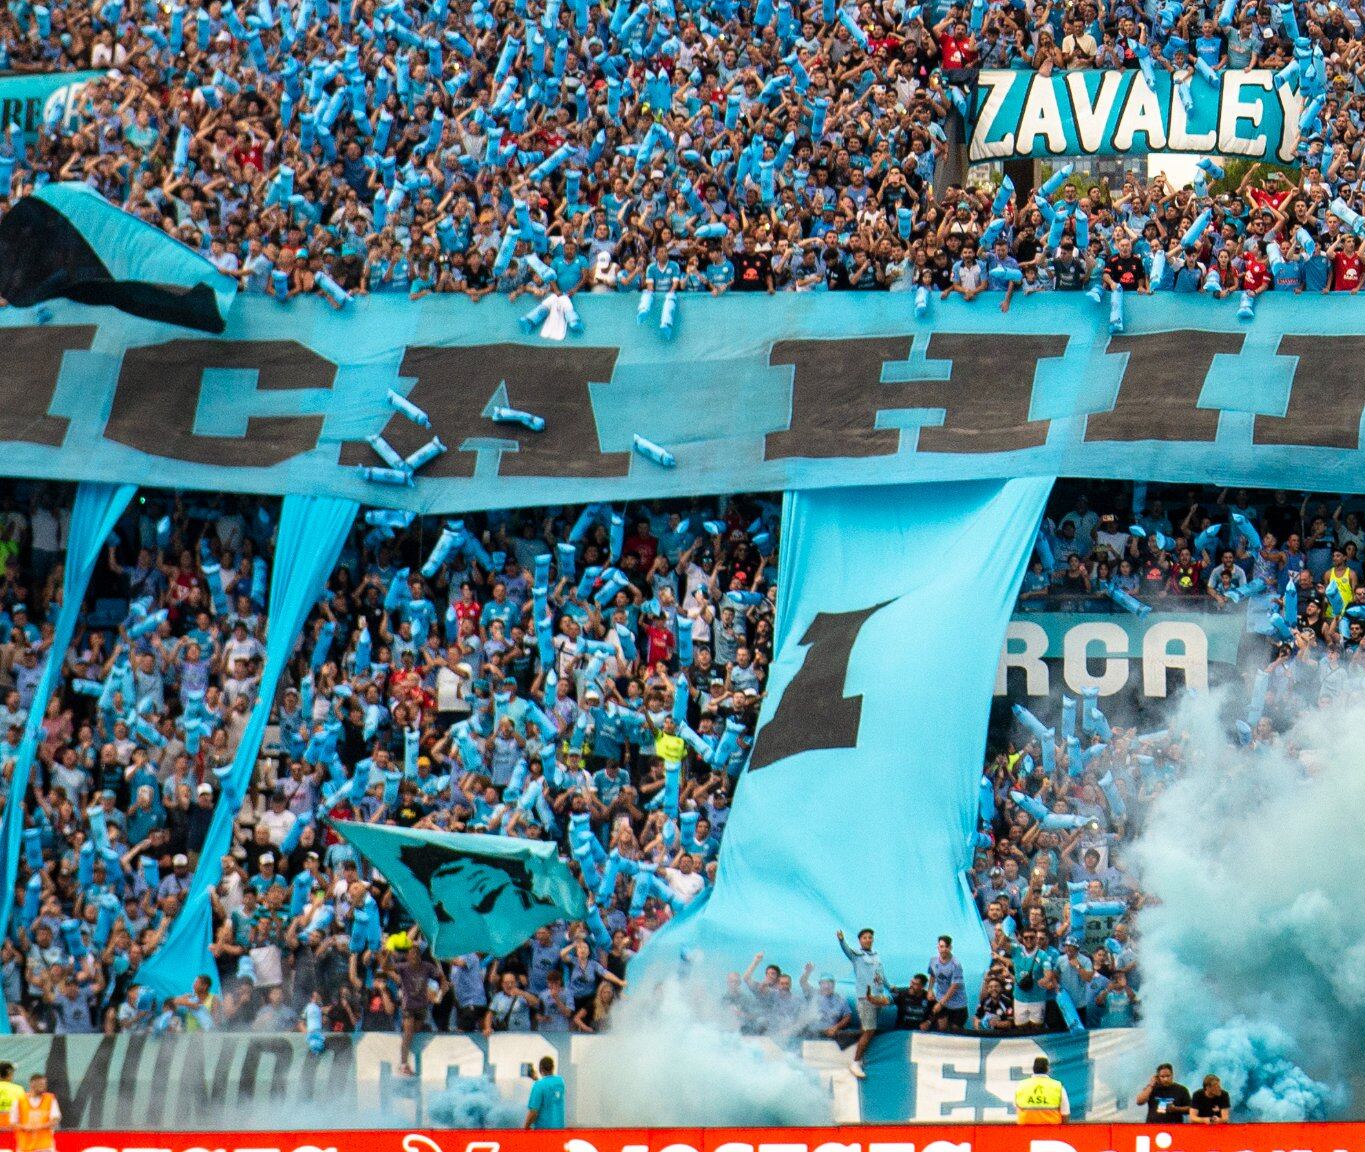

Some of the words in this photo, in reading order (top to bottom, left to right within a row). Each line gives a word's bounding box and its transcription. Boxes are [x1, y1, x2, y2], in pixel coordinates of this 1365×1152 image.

[969, 70, 1304, 161] ZAVALEY
[747, 595, 903, 772] 1
[1027, 1096, 1049, 1105] ASL
